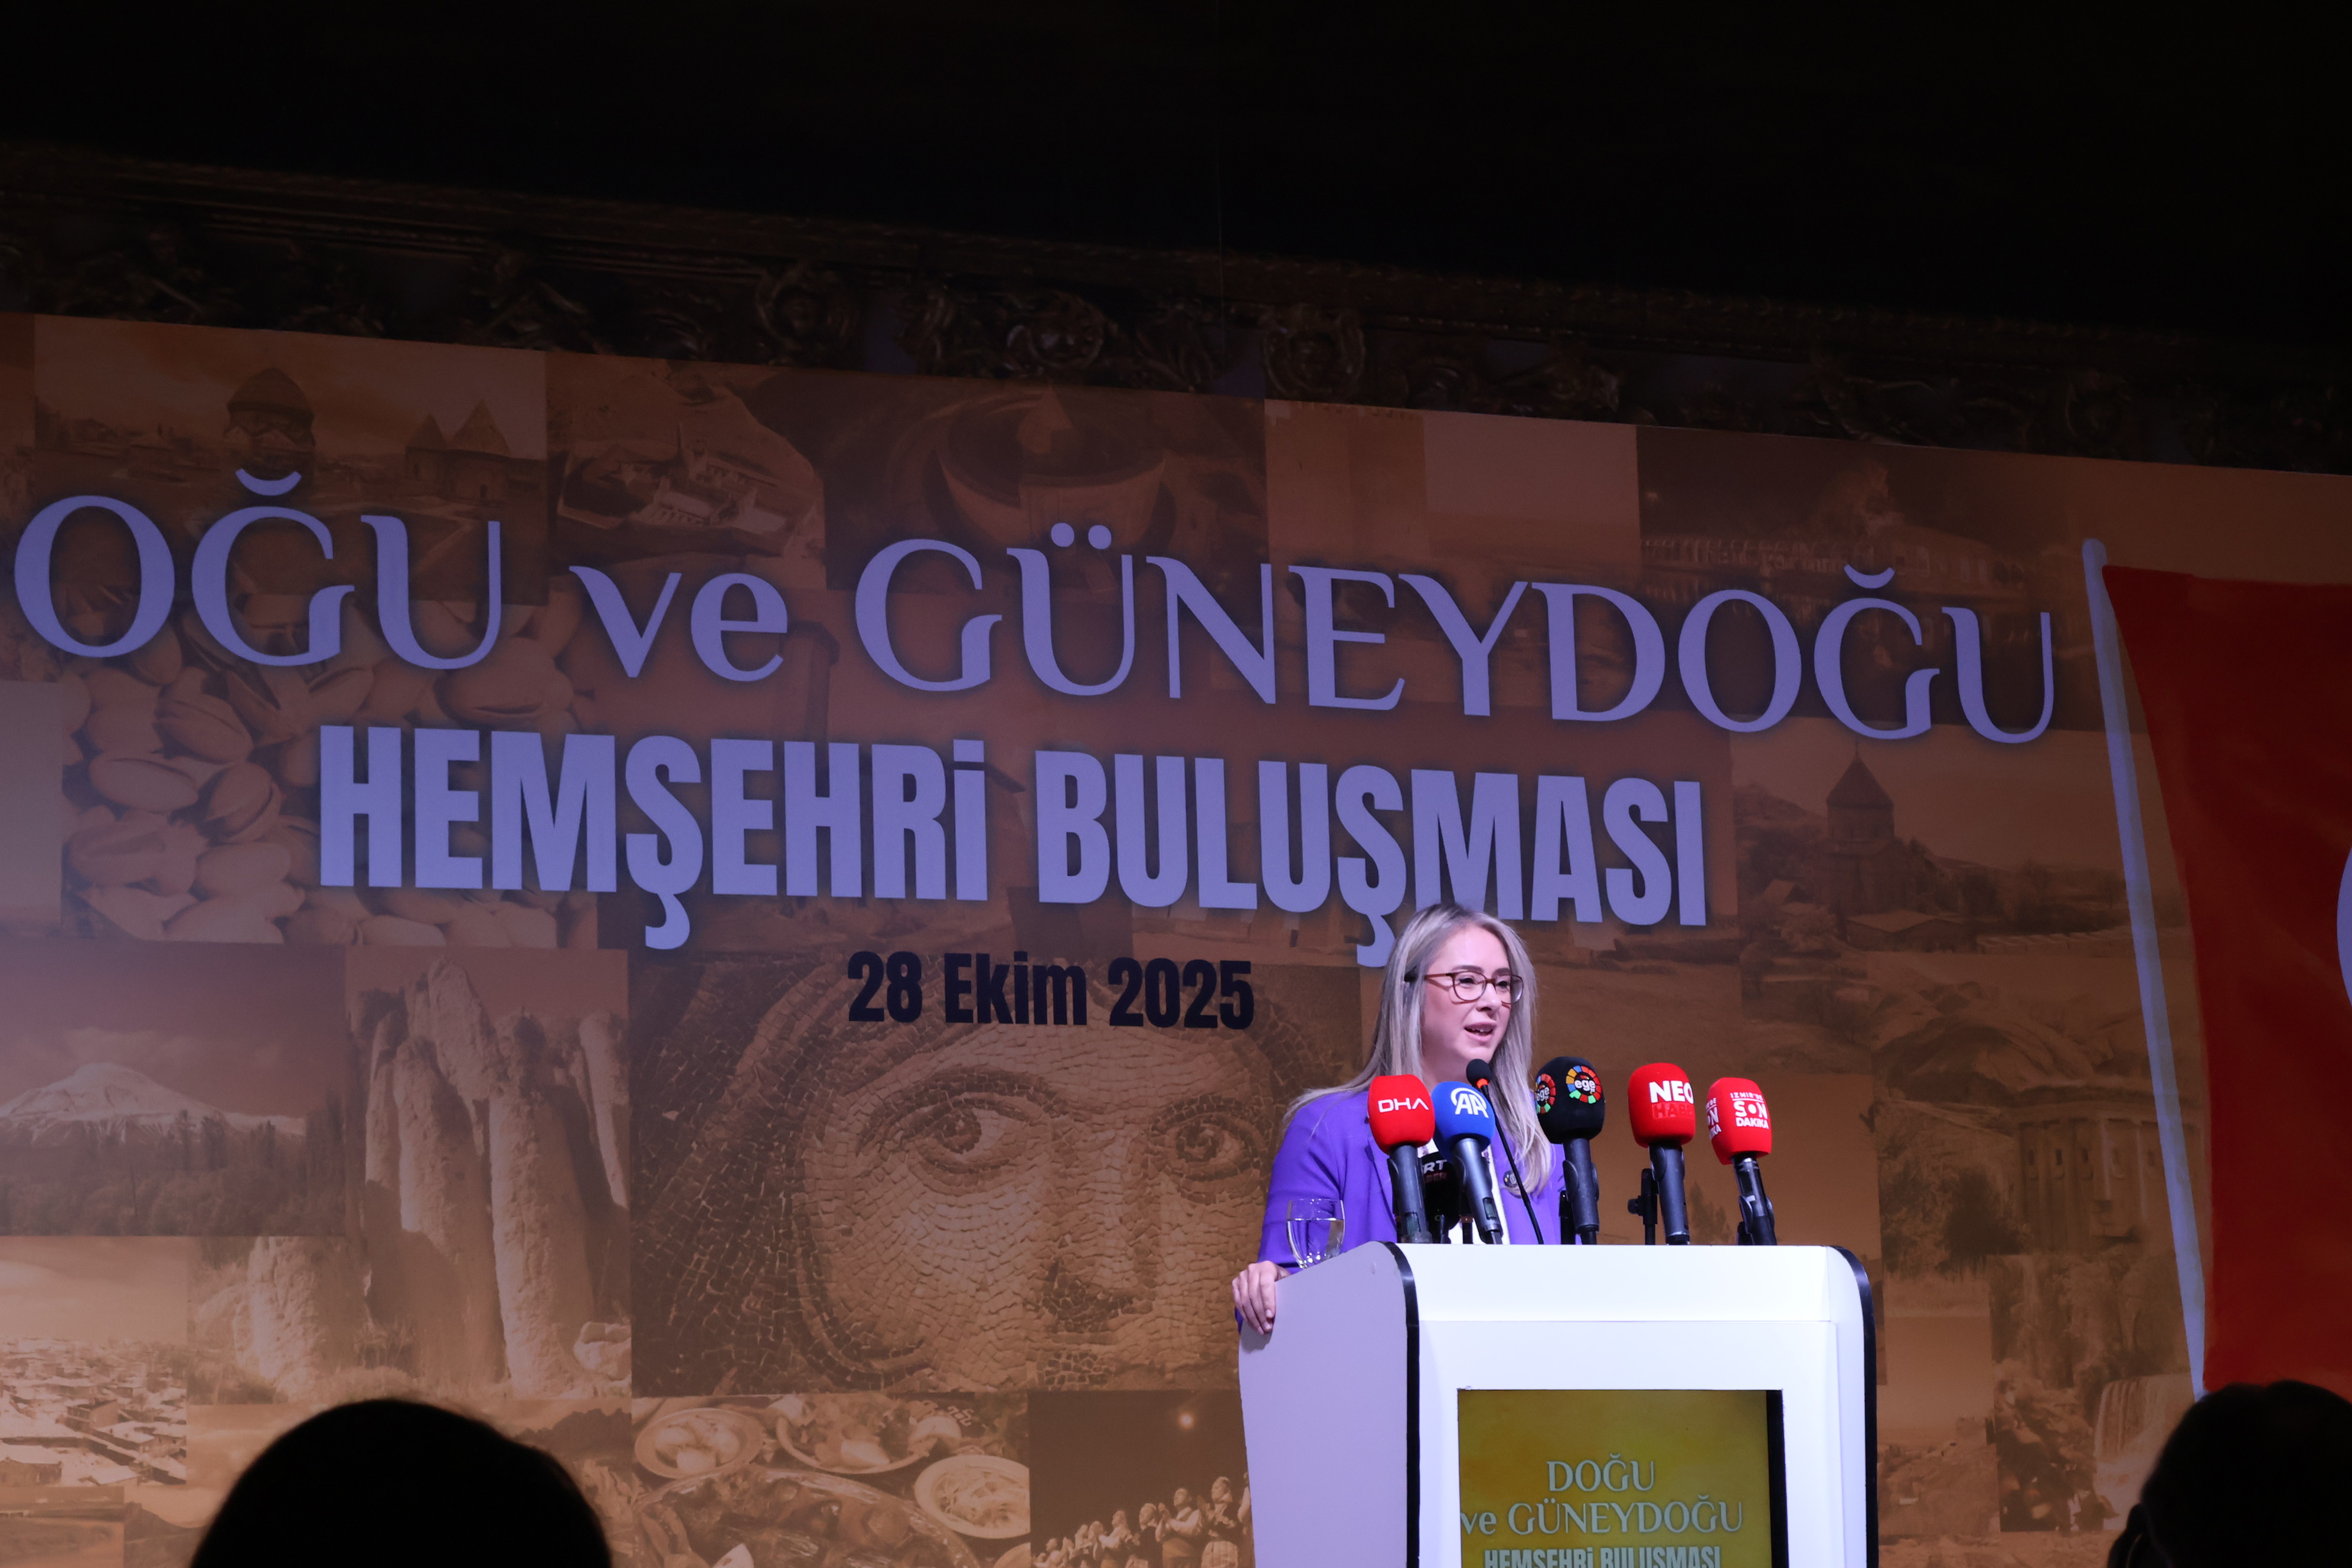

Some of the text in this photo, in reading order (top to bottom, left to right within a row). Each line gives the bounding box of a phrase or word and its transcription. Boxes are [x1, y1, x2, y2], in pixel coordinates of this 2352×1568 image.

[14, 469, 2054, 743] OĞU ve GÜNEYDOĞU
[1035, 750, 1706, 967] BULUŞMASI
[848, 951, 1255, 1028] 28 Ekim 2025
[1574, 1080, 1596, 1091] ege
[1649, 1080, 1694, 1104] NEO
[1377, 1097, 1429, 1113] DHA
[1455, 1093, 1489, 1118] AA
[1422, 1159, 1448, 1174] RT
[1547, 1453, 1654, 1491] DOĞU
[1461, 1494, 1742, 1535] ve GÜNEYDOĞU
